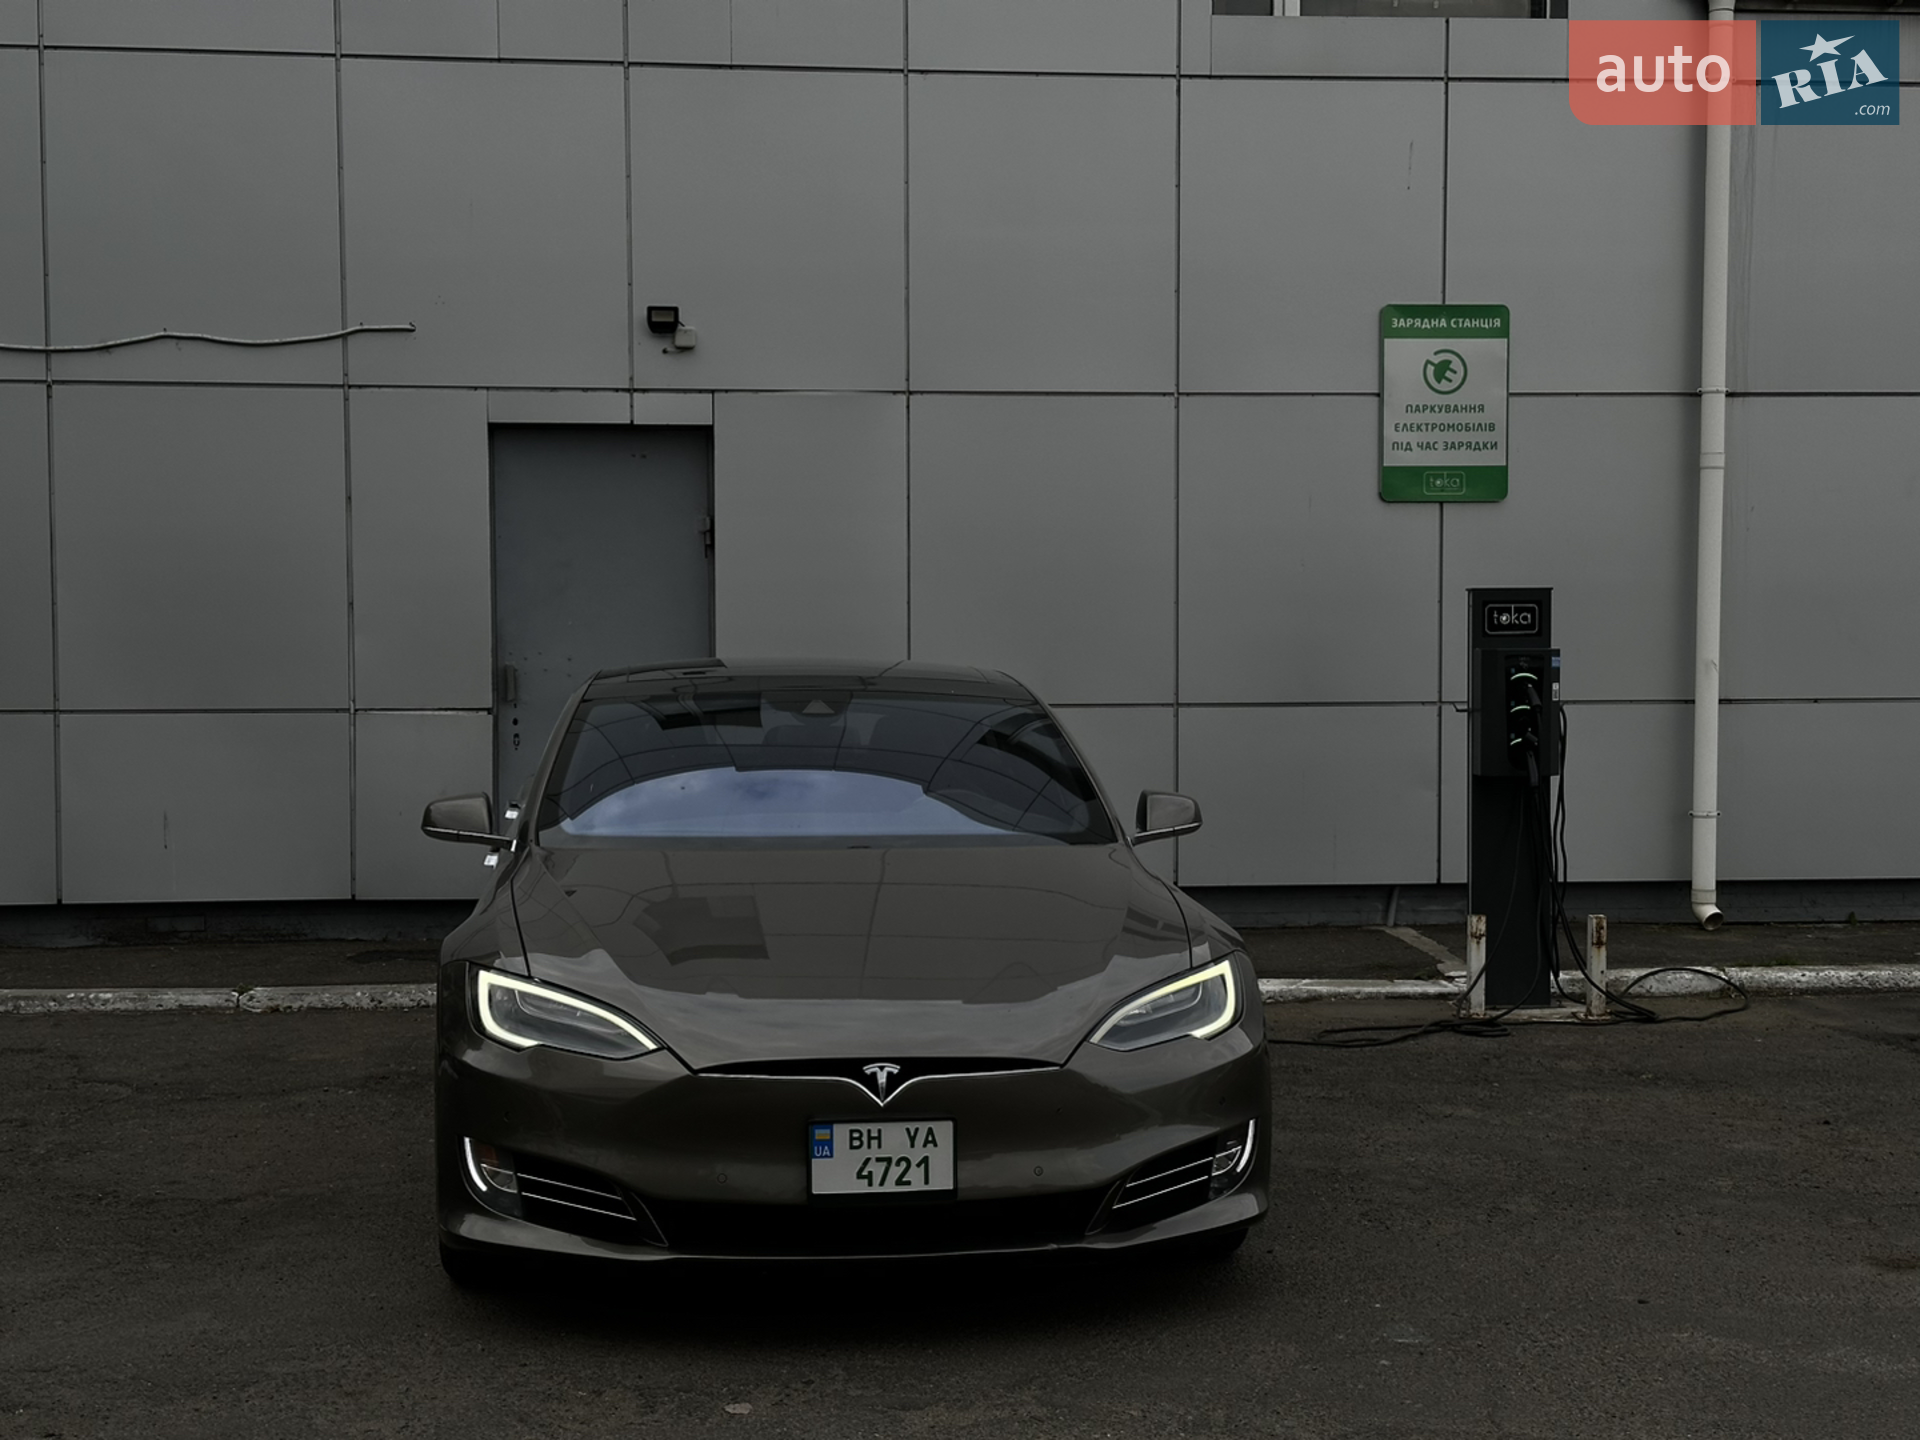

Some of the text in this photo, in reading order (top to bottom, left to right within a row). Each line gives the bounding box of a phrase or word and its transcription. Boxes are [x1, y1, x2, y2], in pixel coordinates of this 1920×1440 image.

[1391, 318, 1501, 329] ЗАРЯДНА СТАНЦІЯ
[1405, 404, 1485, 414] ПАРКУВАННЯ
[1394, 422, 1496, 432] ЕЛЕКТРОМОБІЛІВ
[1392, 441, 1498, 452] ПІД ЧАС ЗАРЯДКИ
[1429, 472, 1460, 488] toka
[1493, 605, 1531, 624] toka
[849, 1126, 938, 1150] BH YA
[814, 1146, 831, 1158] UA
[856, 1155, 930, 1187] 4721
